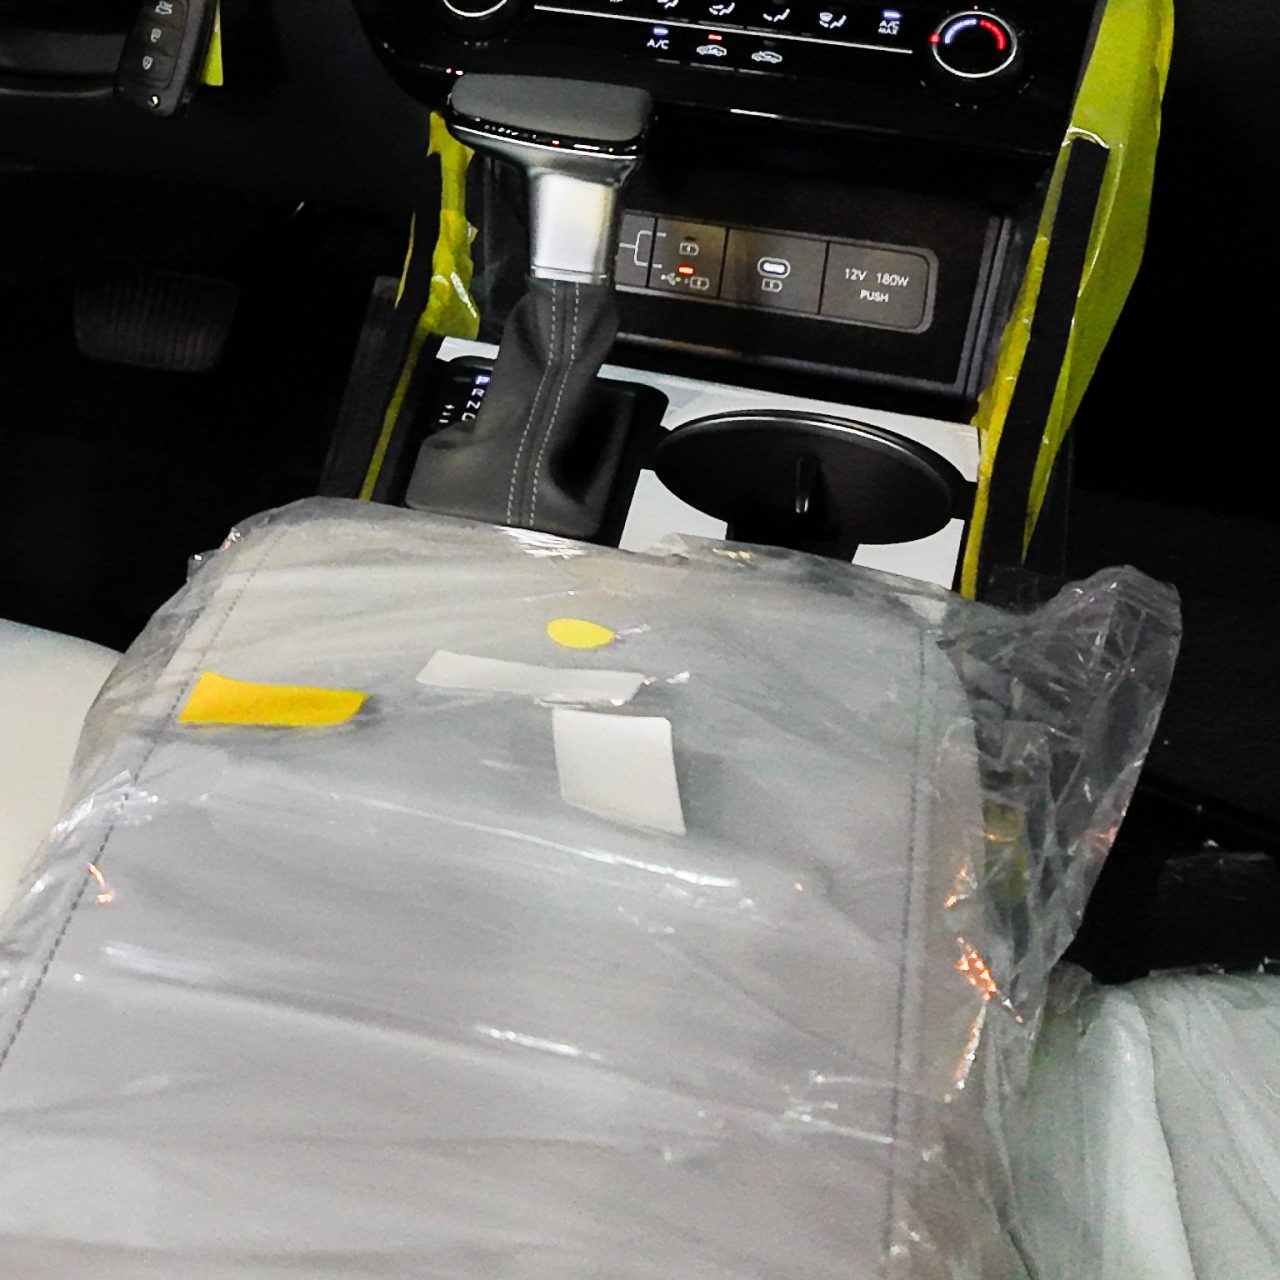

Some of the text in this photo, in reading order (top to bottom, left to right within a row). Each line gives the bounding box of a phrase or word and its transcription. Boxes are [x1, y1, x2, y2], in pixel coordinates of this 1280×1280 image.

[646, 38, 670, 50] A/C
[845, 268, 910, 287] 12V 180W
[860, 289, 889, 303] PUSH
[475, 375, 491, 385] P
[466, 400, 481, 409] N
